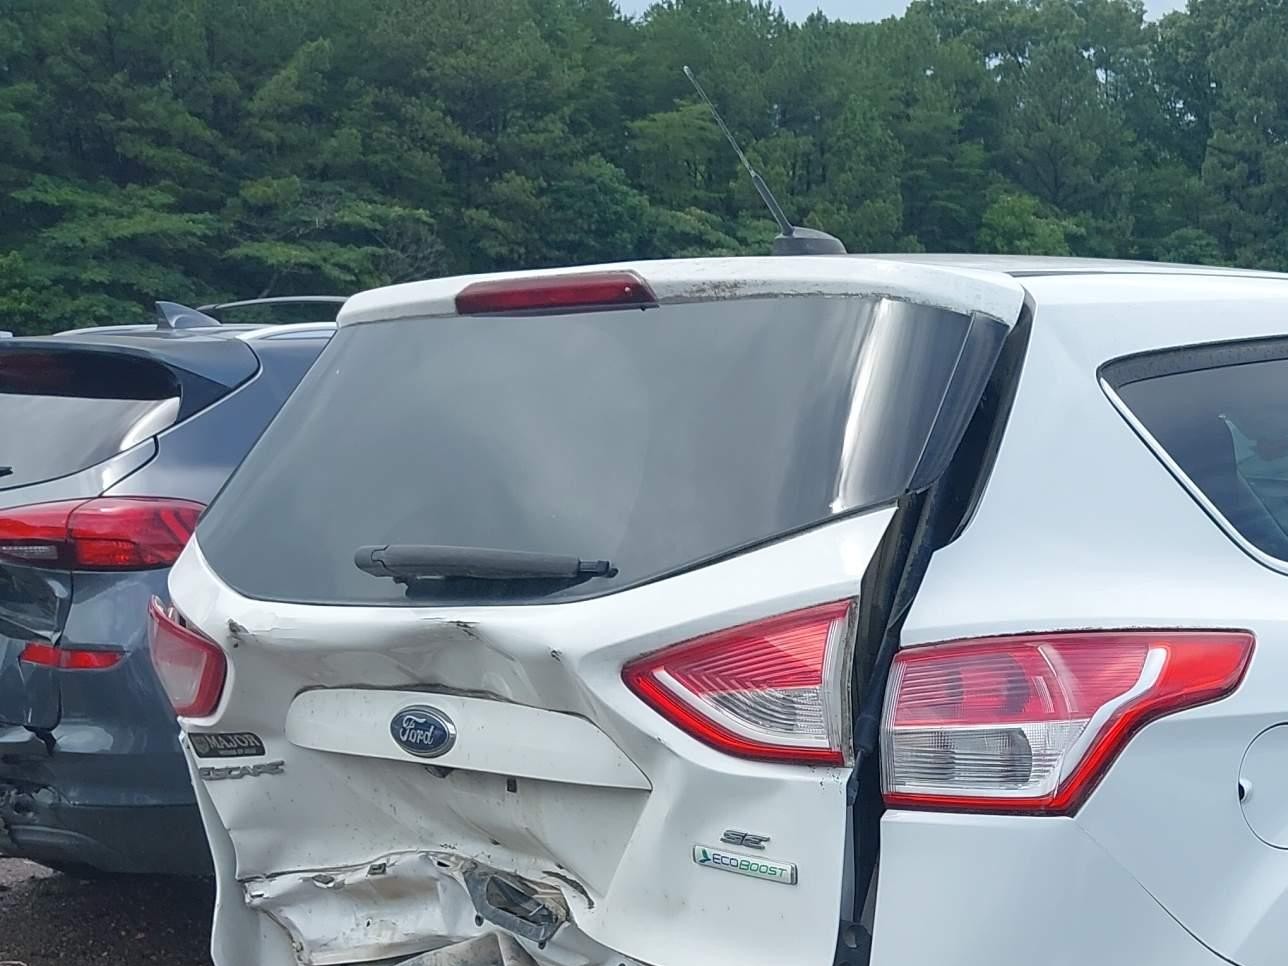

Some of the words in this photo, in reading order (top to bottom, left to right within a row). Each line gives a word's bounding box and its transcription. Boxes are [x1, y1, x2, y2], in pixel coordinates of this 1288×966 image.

[399, 715, 435, 745] Ford
[204, 734, 261, 750] MAJOR
[199, 760, 285, 781] ESCAPE
[719, 829, 771, 850] SE
[712, 853, 788, 878] ECOBOOST
